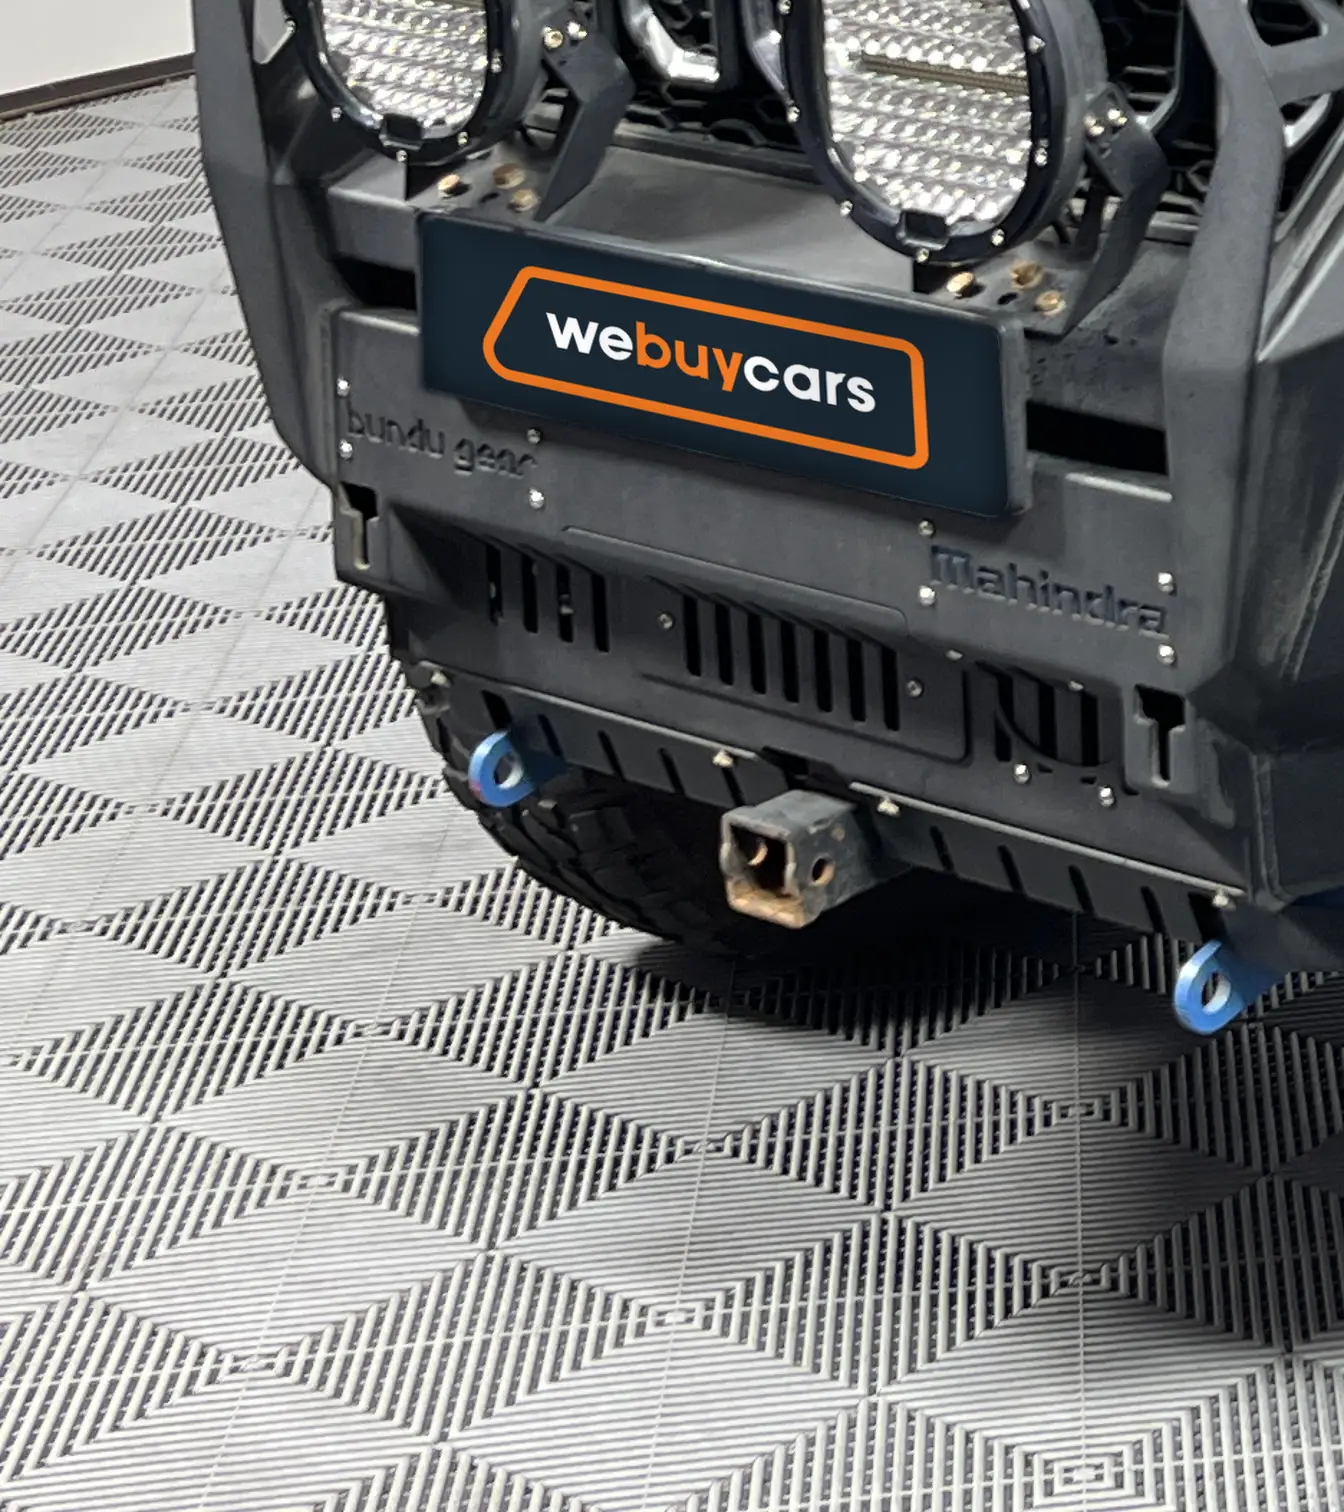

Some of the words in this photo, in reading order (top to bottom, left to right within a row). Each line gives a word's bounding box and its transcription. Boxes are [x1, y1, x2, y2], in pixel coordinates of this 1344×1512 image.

[545, 311, 876, 414] webuycars
[347, 398, 445, 459] bundu
[453, 437, 538, 479] gear
[929, 543, 1172, 642] Mahindra
